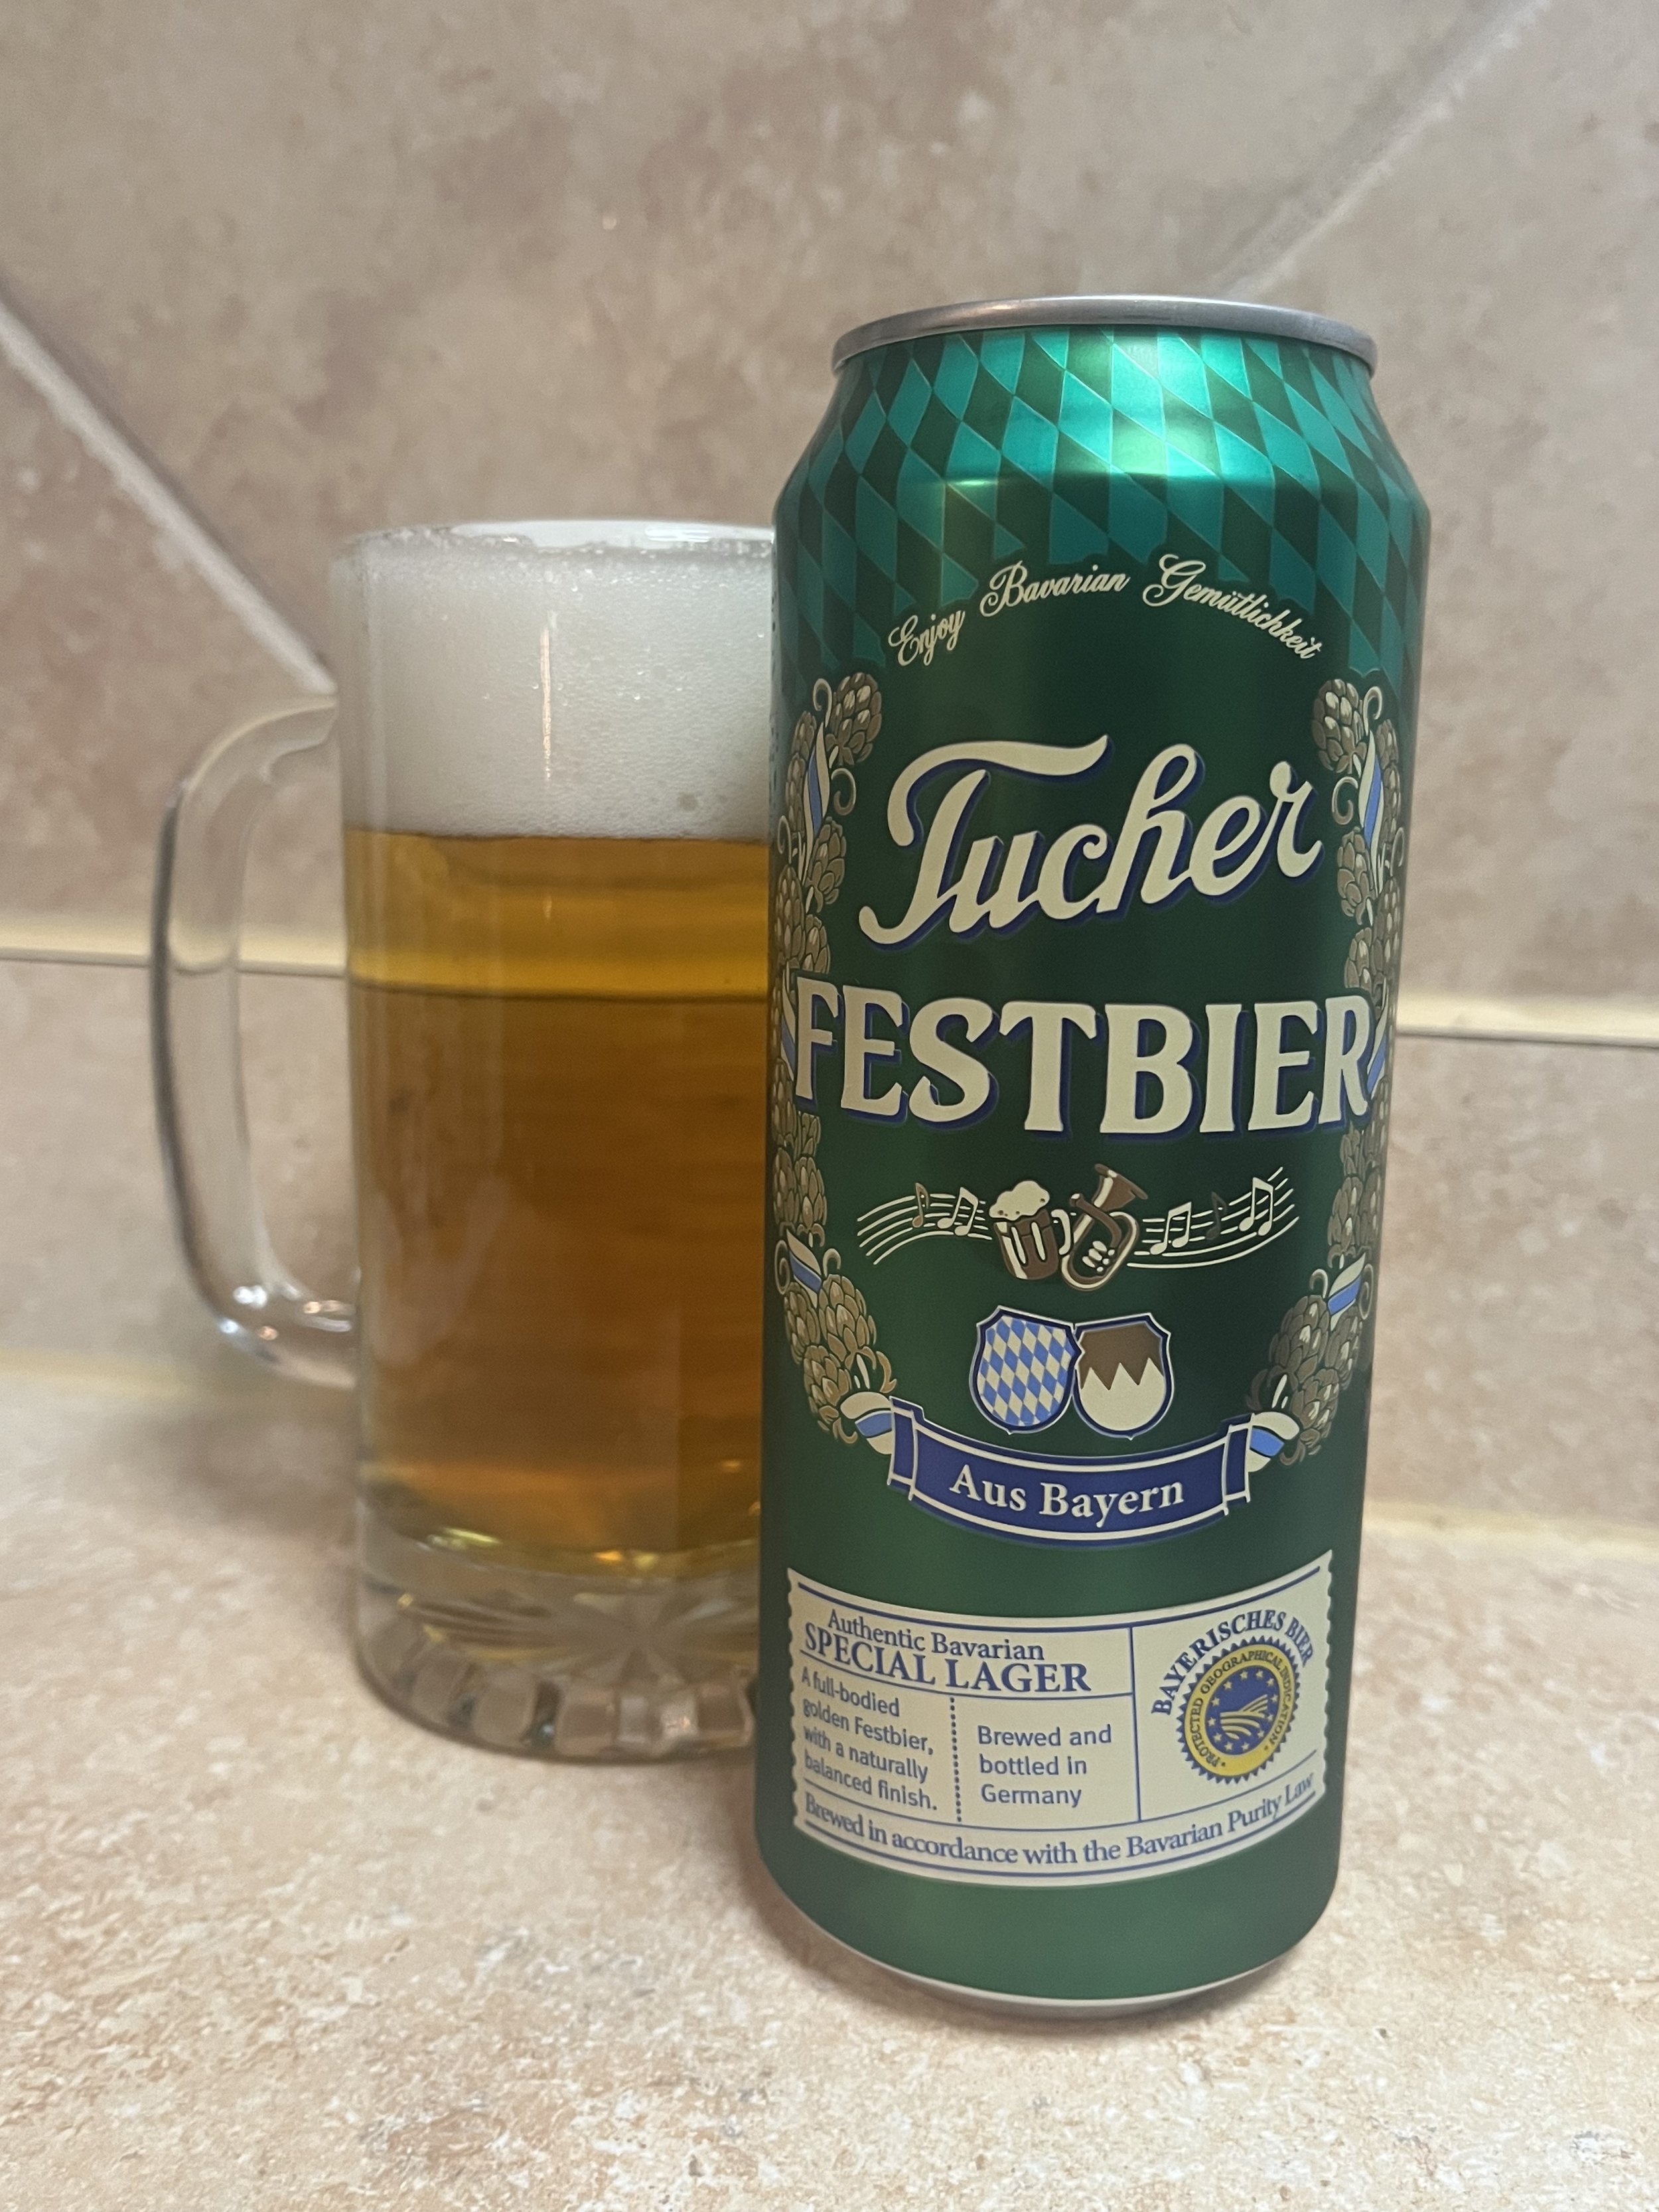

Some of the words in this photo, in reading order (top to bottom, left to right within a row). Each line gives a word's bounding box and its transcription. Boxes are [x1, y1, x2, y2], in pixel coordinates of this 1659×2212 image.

[889, 610, 965, 666] Enjoy
[980, 560, 1130, 617] Bavarian
[1143, 554, 1322, 659] Gemütlichkeit
[858, 734, 1323, 946] Tucher
[795, 976, 1371, 1135] FESTBIER
[950, 1464, 1027, 1511] Aus
[1039, 1481, 1184, 1528] Bayern
[804, 1622, 936, 1685] SPECIAL
[946, 1659, 1092, 1693] LAGER
[828, 1609, 926, 1652] Authentic
[931, 1632, 1045, 1660] Bavarian
[1151, 1609, 1287, 1716] BAYERISCHES
[1285, 1617, 1314, 1666] BIER
[801, 1666, 811, 1685] A
[813, 1672, 900, 1717] full-bodied
[1201, 1649, 1282, 1694] GEOGRAPHICAL
[803, 1699, 849, 1732] golden
[855, 1716, 934, 1755] Festbier,
[977, 1726, 1061, 1747] Brewed
[1070, 1724, 1112, 1745] and
[1189, 1697, 1221, 1768] PROTECTED
[1269, 1665, 1292, 1745] INDICATION
[803, 1725, 831, 1752] with
[835, 1741, 844, 1758] a
[849, 1748, 928, 1784] naturally
[804, 1754, 872, 1795] balanced
[878, 1778, 938, 1810] finish.
[979, 1753, 1058, 1775] bottled
[1067, 1755, 1087, 1775] in
[805, 1792, 864, 1837] Brewed
[869, 1821, 888, 1845] in
[892, 1831, 1018, 1864] accordance
[1023, 1842, 1077, 1864] with
[1084, 1840, 1121, 1862] the
[1126, 1824, 1223, 1858] Bavarian
[1228, 1794, 1281, 1832] Purity
[1285, 1772, 1315, 1806] Law
[981, 1784, 1082, 1808] Germany
